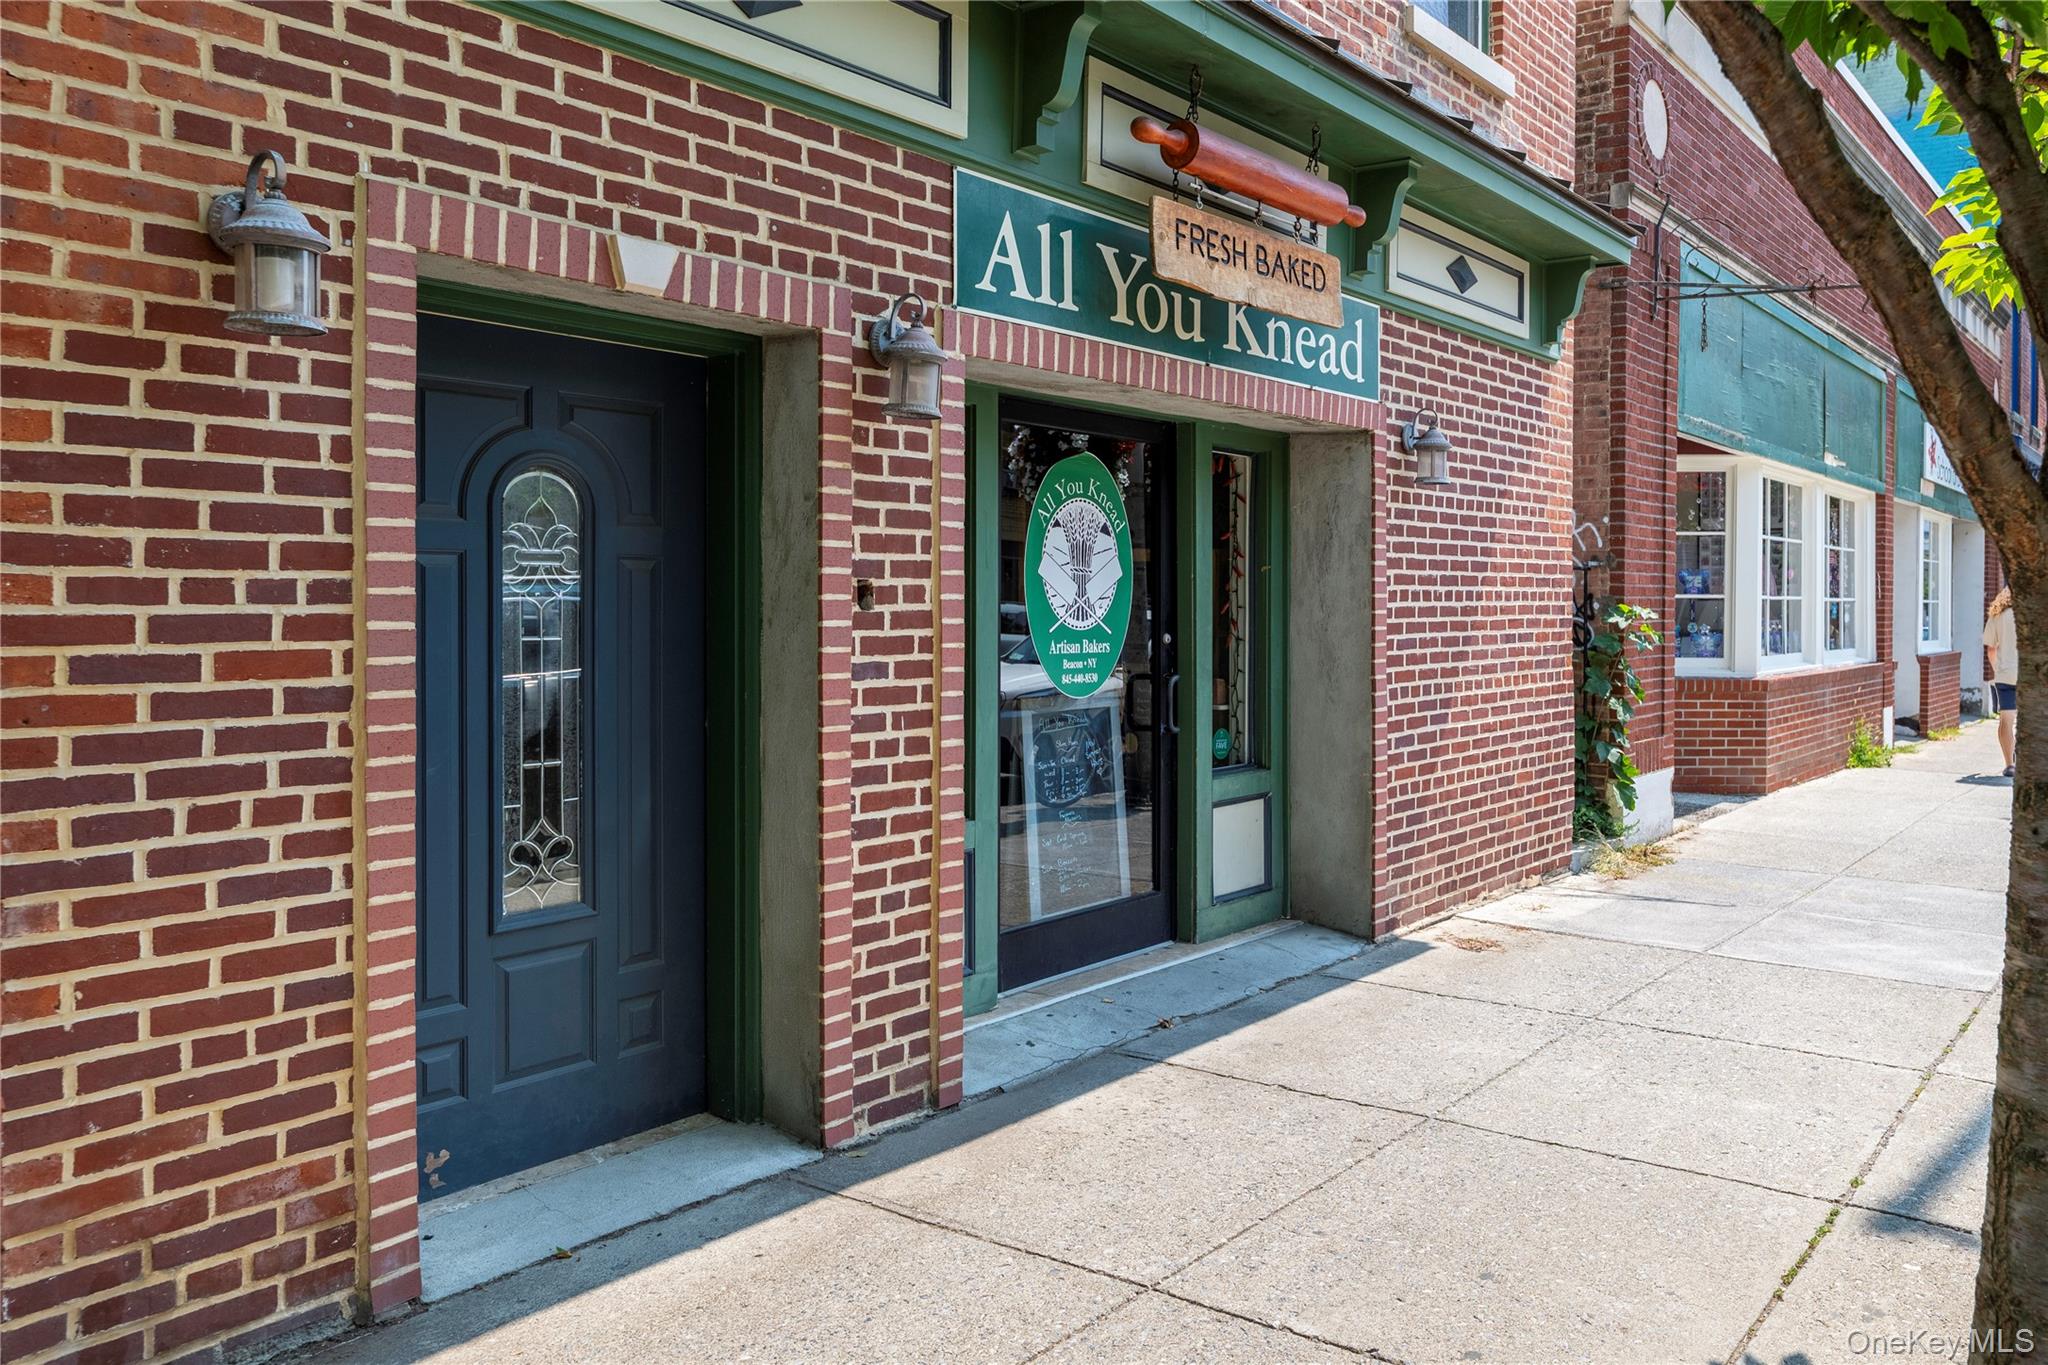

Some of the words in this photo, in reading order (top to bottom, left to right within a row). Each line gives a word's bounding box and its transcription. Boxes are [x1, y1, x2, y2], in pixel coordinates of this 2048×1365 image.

[1175, 217, 1248, 271] FRESH
[1256, 244, 1327, 294] BAKED
[975, 210, 1079, 312] All
[1096, 242, 1205, 343] You
[1222, 302, 1365, 383] Knead
[1038, 492, 1056, 528] All
[1054, 478, 1084, 500] You
[1088, 477, 1126, 534] Knead
[1049, 639, 1081, 655] Artisan
[1082, 639, 1111, 653] Bakers
[1063, 658, 1084, 669] Beacon
[1087, 657, 1098, 668] NY
